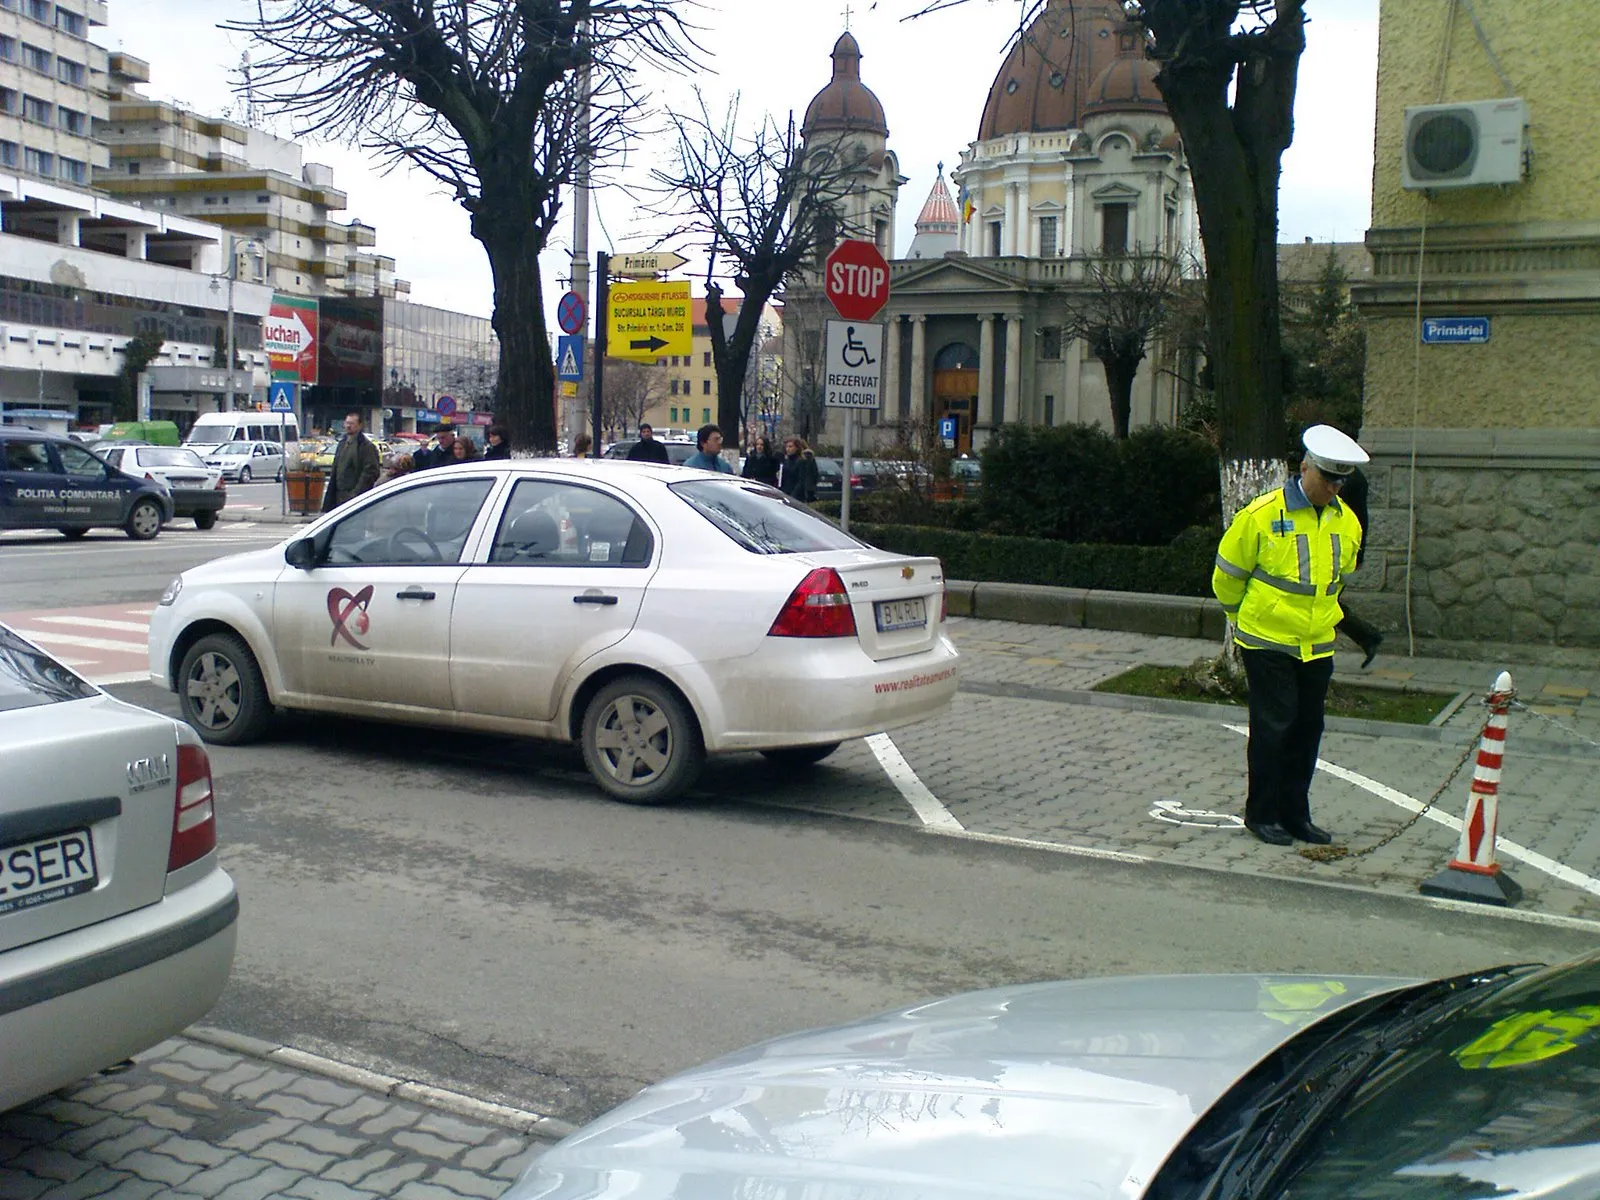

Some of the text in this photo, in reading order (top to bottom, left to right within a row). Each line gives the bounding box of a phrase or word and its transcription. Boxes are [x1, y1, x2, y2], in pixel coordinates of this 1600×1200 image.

[831, 262, 885, 299] STOP
[614, 307, 646, 318] SUCURSALA
[828, 374, 878, 388] REZERVAT
[829, 392, 876, 405] 2 LOCURI
[884, 605, 892, 624] B
